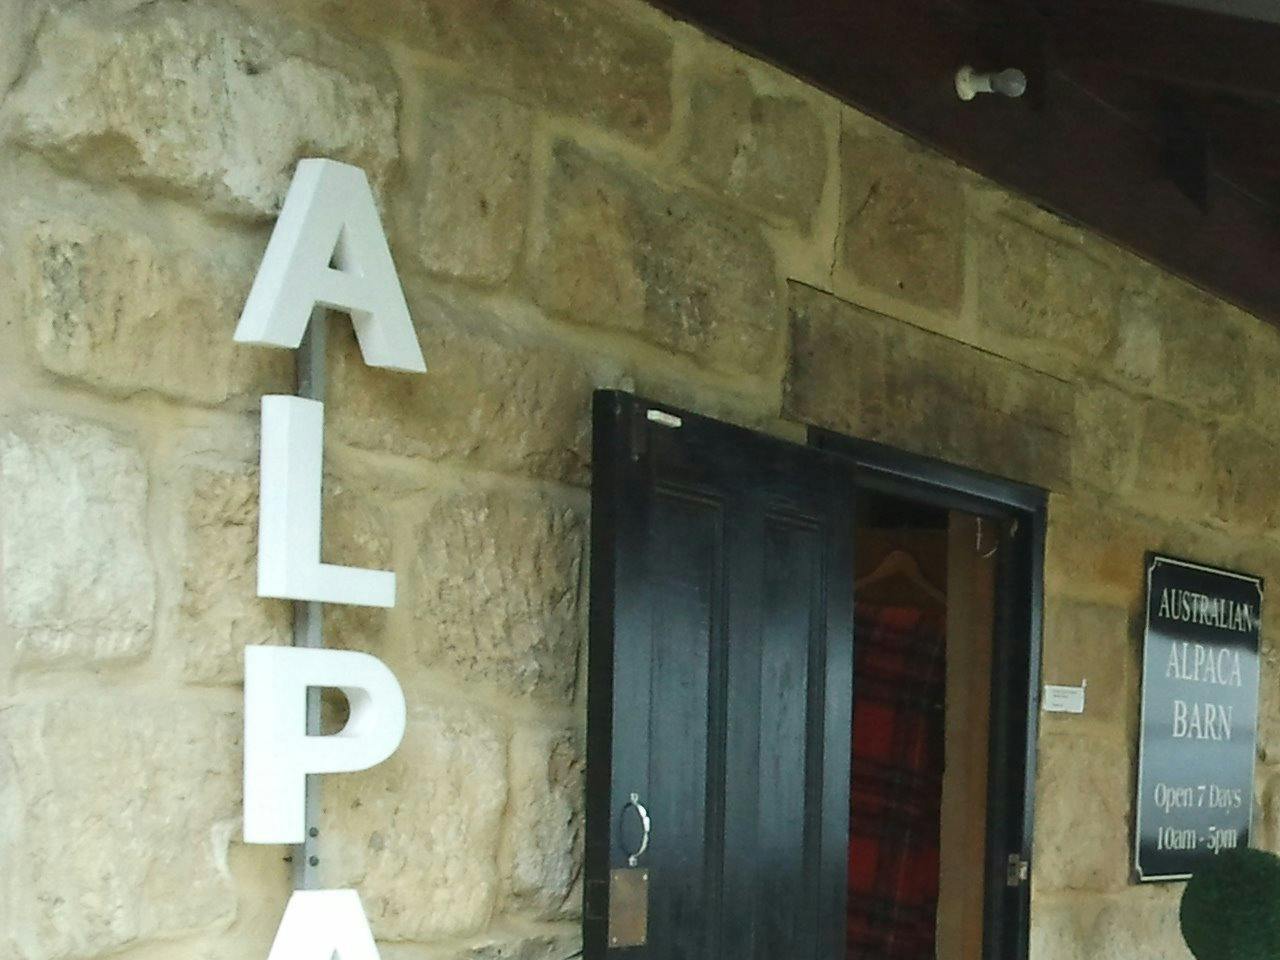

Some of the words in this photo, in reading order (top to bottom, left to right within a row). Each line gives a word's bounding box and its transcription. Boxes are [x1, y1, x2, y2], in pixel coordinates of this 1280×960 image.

[1158, 587, 1254, 632] AUSTRALIAN
[1166, 641, 1242, 687] ALPACA
[1172, 699, 1234, 741] BARN
[1154, 782, 1193, 814] Open
[1197, 785, 1206, 807] 7
[1209, 784, 1242, 815] Days
[1157, 826, 1196, 850] 10am
[1206, 826, 1238, 855] 5pm
